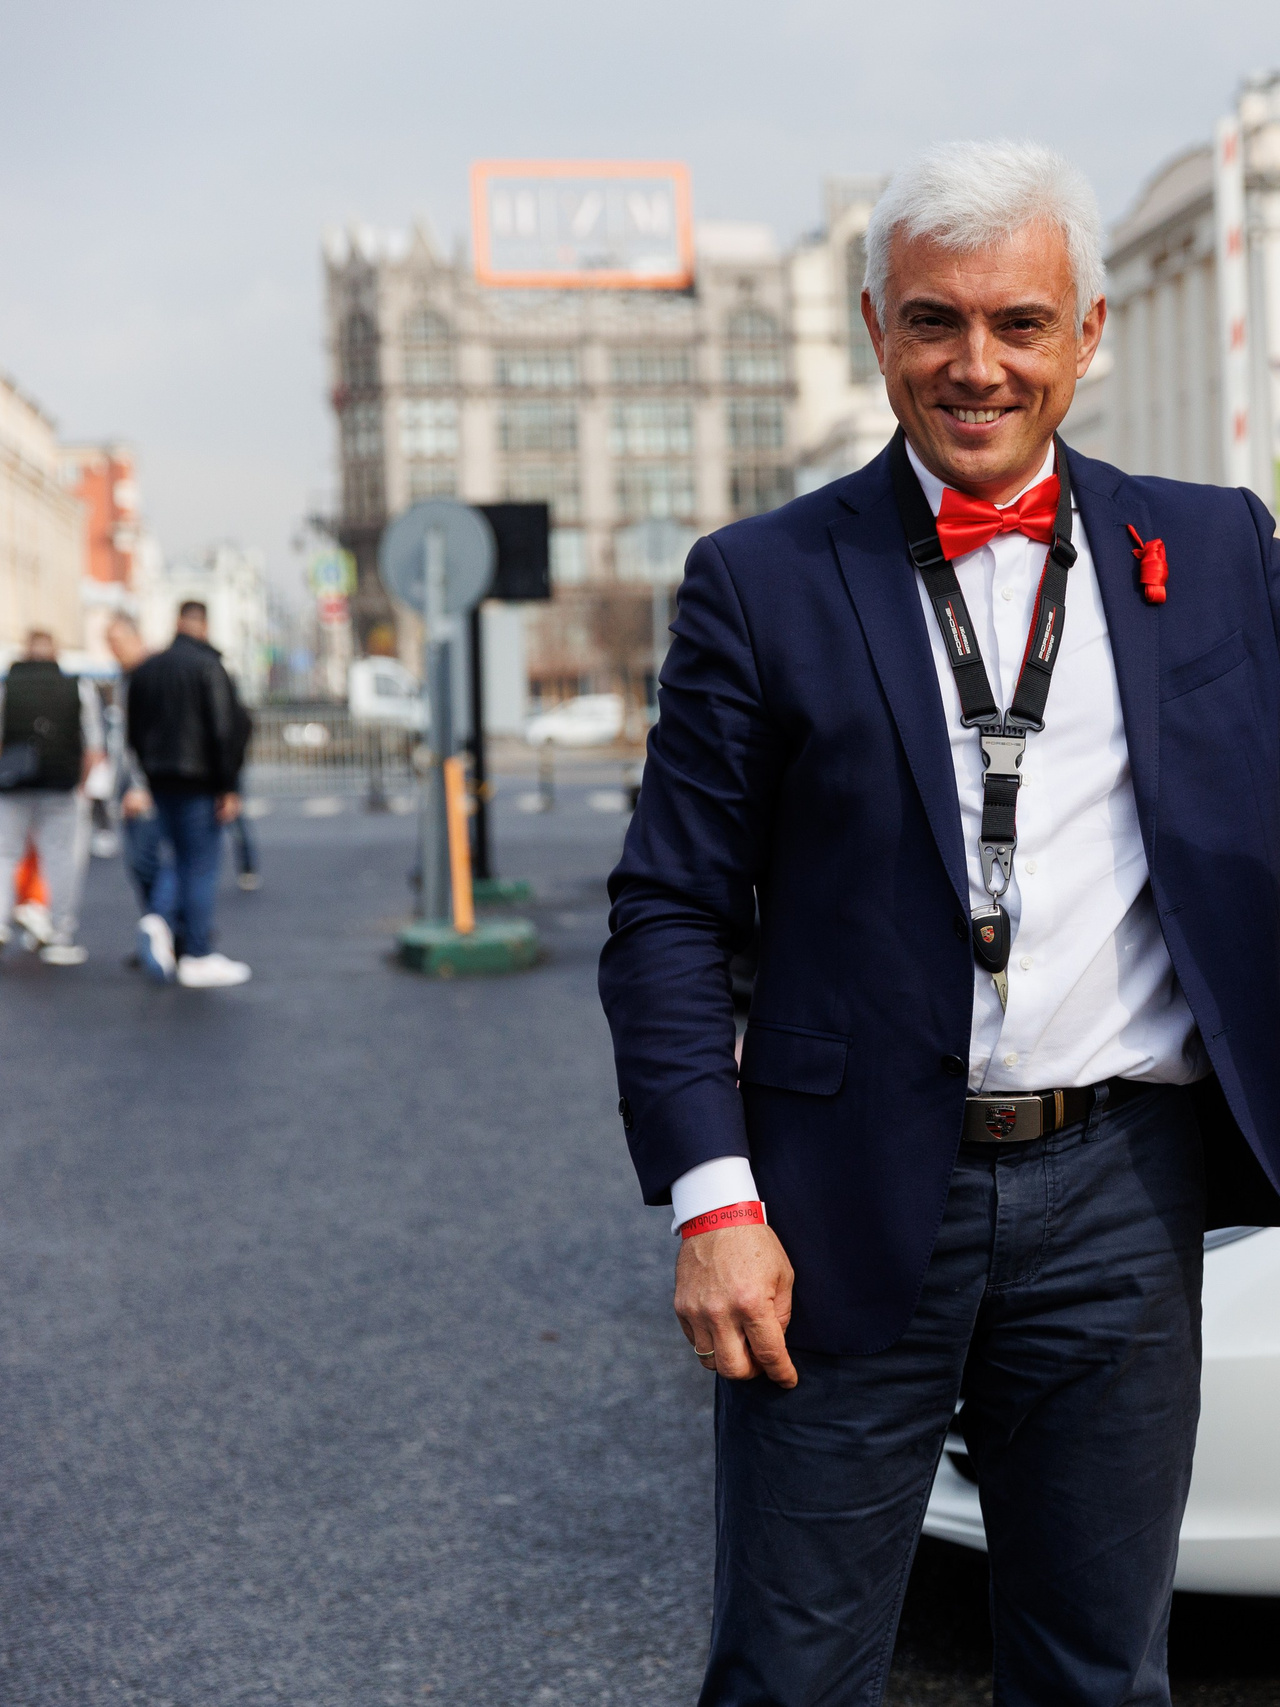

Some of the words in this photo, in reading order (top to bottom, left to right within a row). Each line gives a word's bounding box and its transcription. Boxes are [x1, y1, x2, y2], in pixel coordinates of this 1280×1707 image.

[945, 607, 963, 656] PORSCHE
[1038, 611, 1054, 660] PORSCHE
[699, 1213, 718, 1227] Club
[720, 1208, 759, 1220] Porsche
